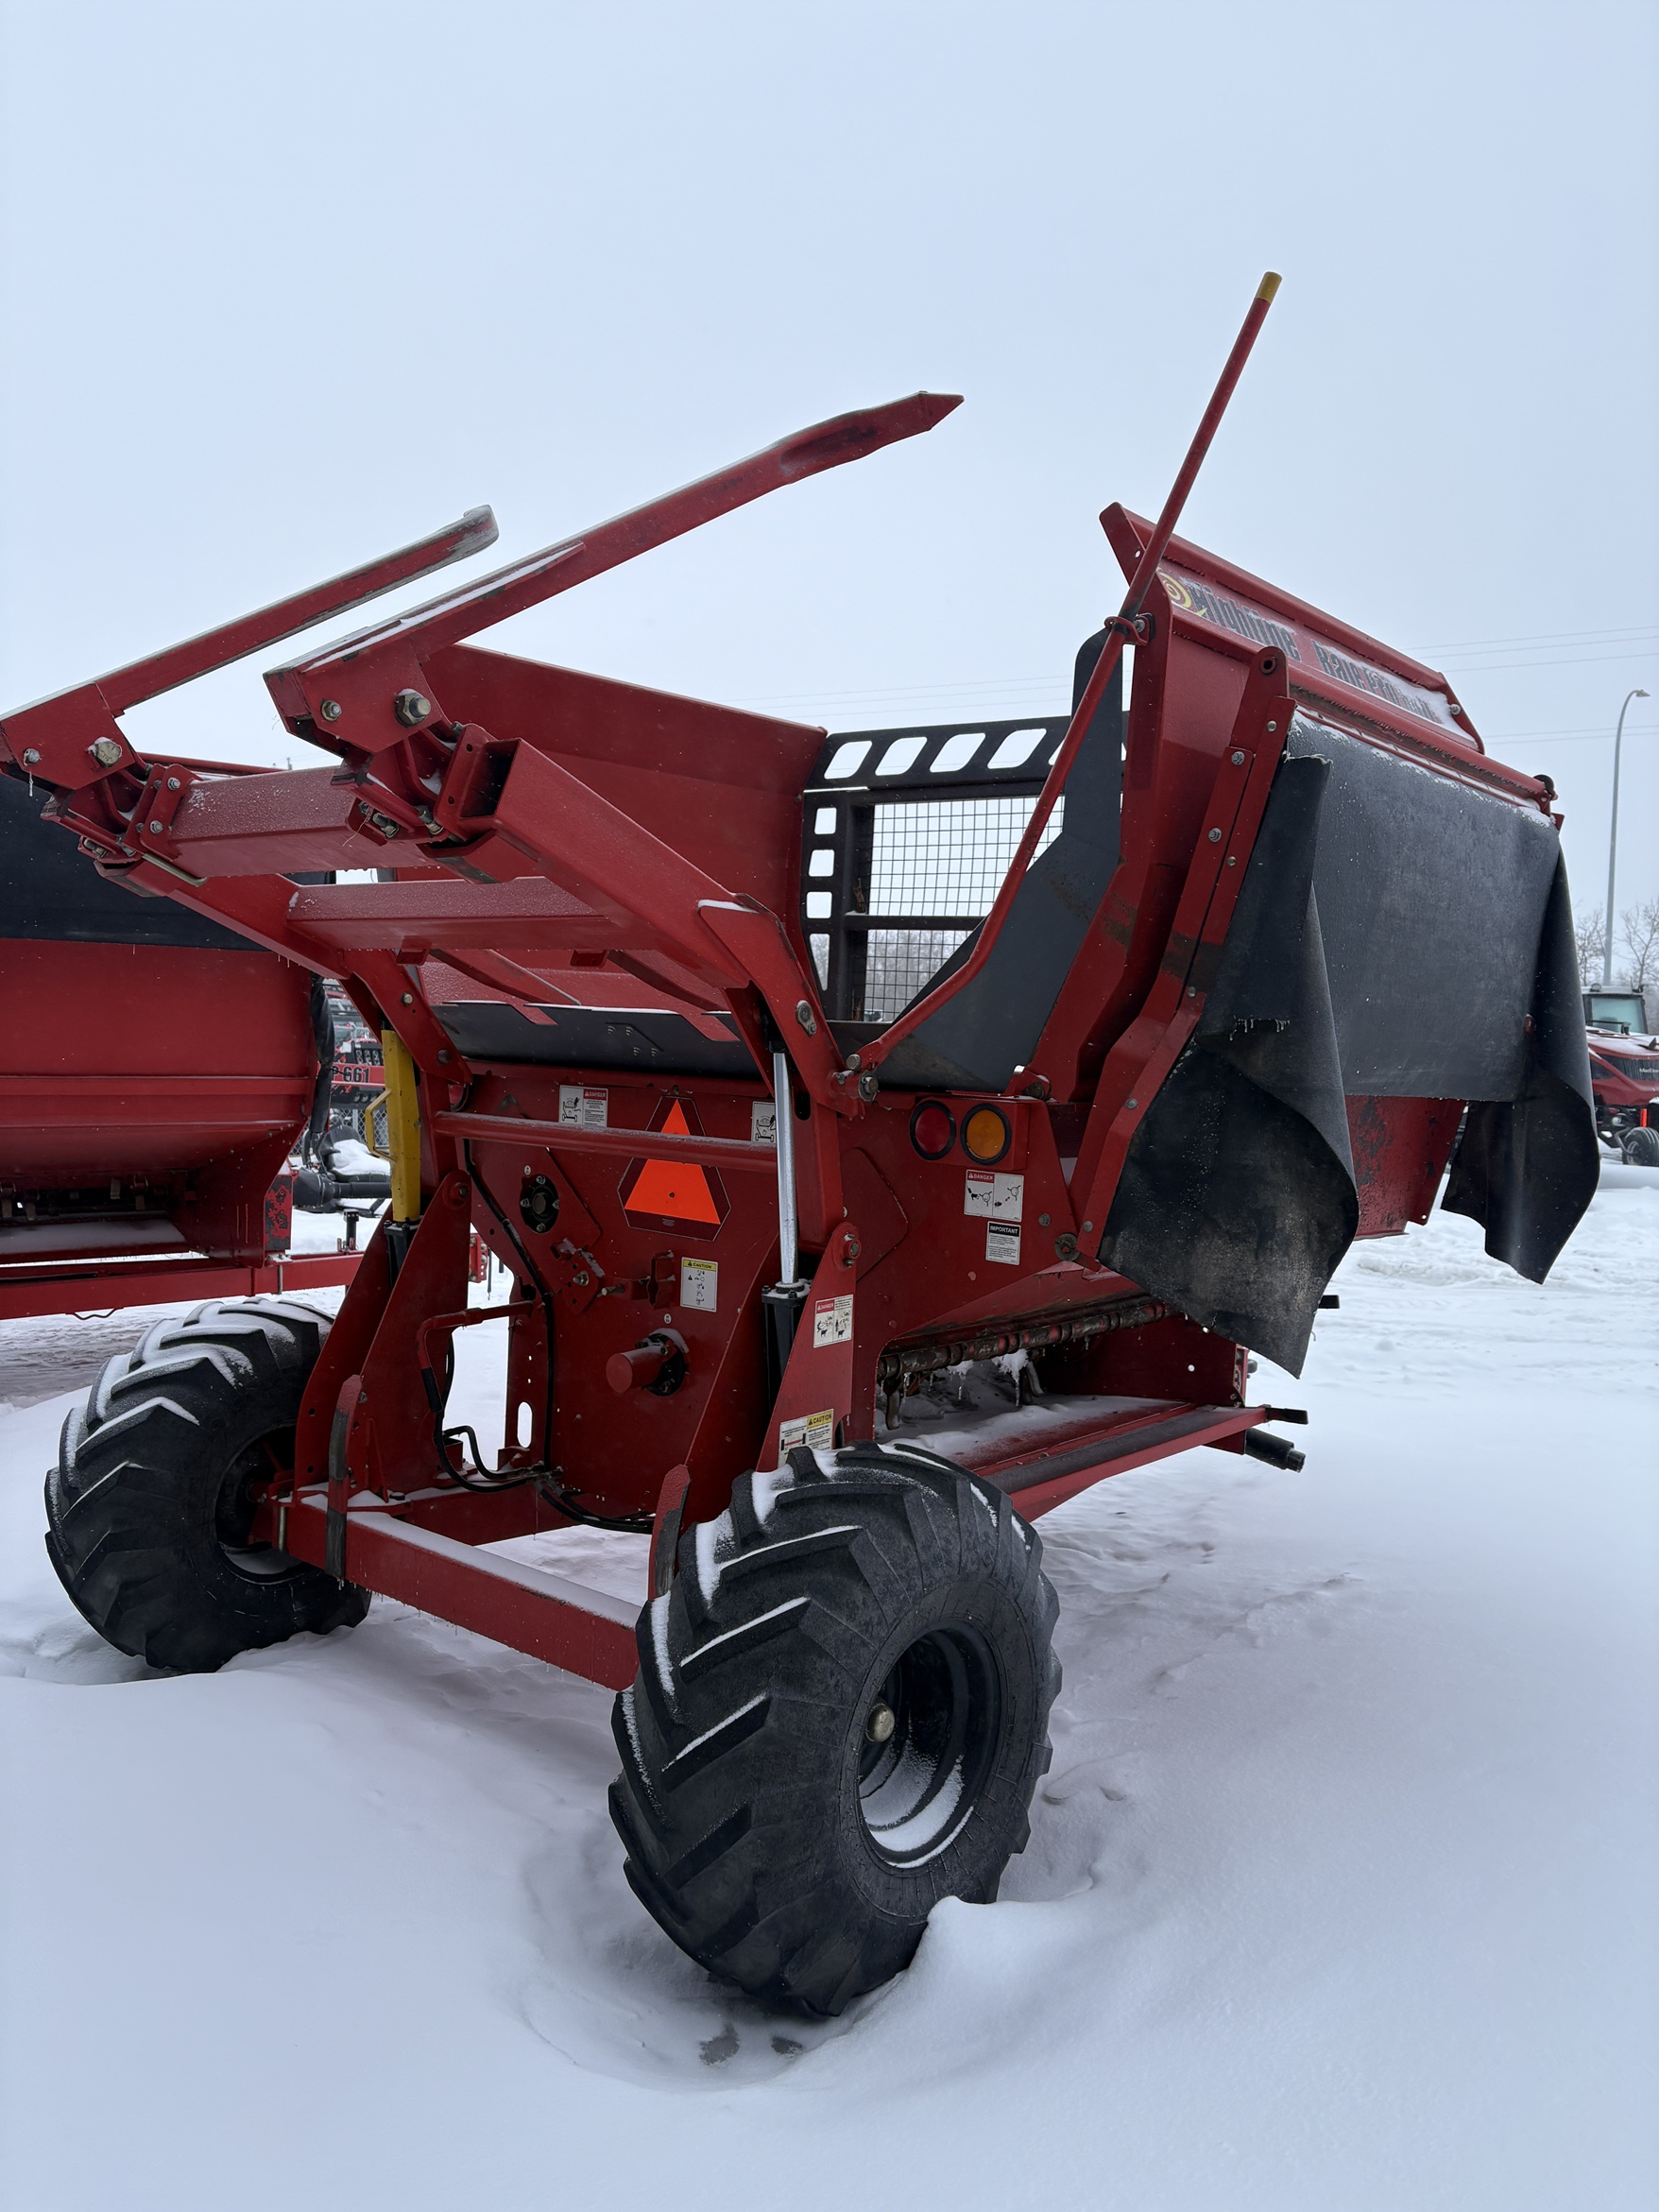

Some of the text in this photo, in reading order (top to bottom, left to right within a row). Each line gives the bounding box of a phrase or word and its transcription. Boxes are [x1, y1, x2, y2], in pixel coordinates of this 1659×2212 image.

[343, 1067, 369, 1083] 661
[990, 1226, 1018, 1234] IMPORTANT
[813, 1415, 831, 1423] CAUTION
